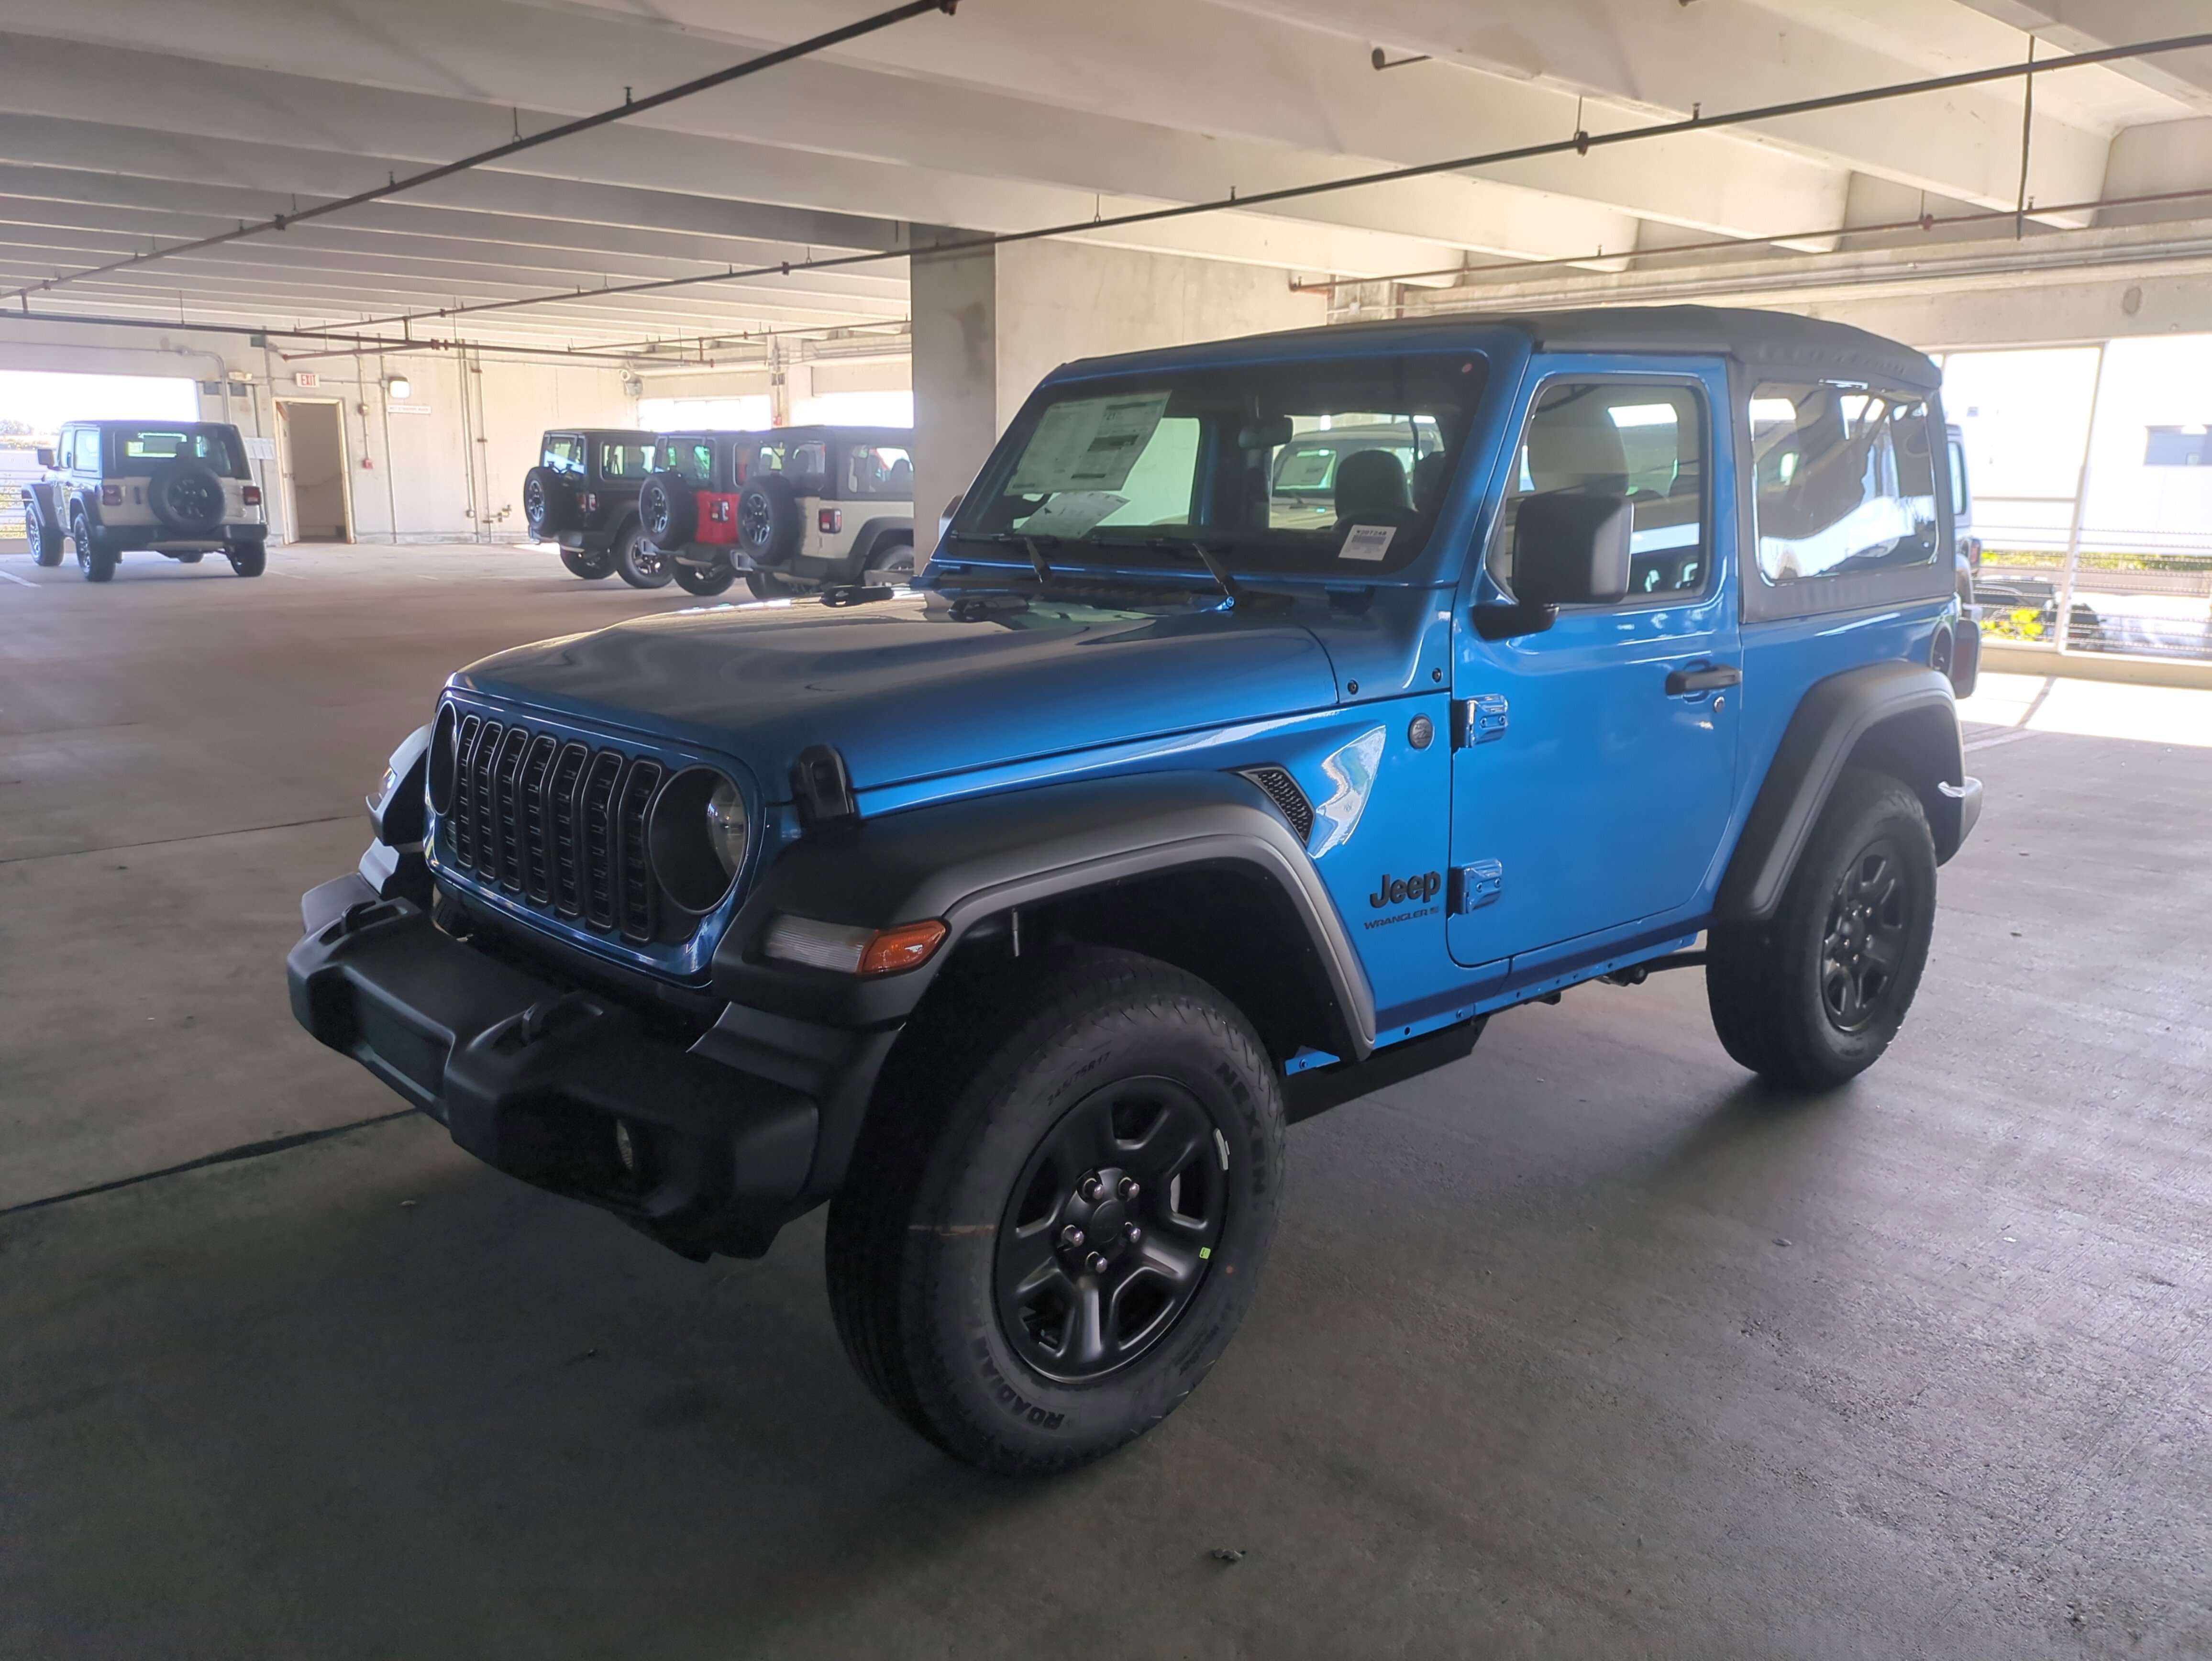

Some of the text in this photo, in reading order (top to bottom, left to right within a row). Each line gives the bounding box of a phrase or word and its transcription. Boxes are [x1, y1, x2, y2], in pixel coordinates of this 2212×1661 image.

[301, 375, 316, 386] EXIT
[1370, 871, 1441, 908] Jeep
[1364, 909, 1427, 930] WRANGLER
[1216, 1062, 1266, 1196] NEXEN
